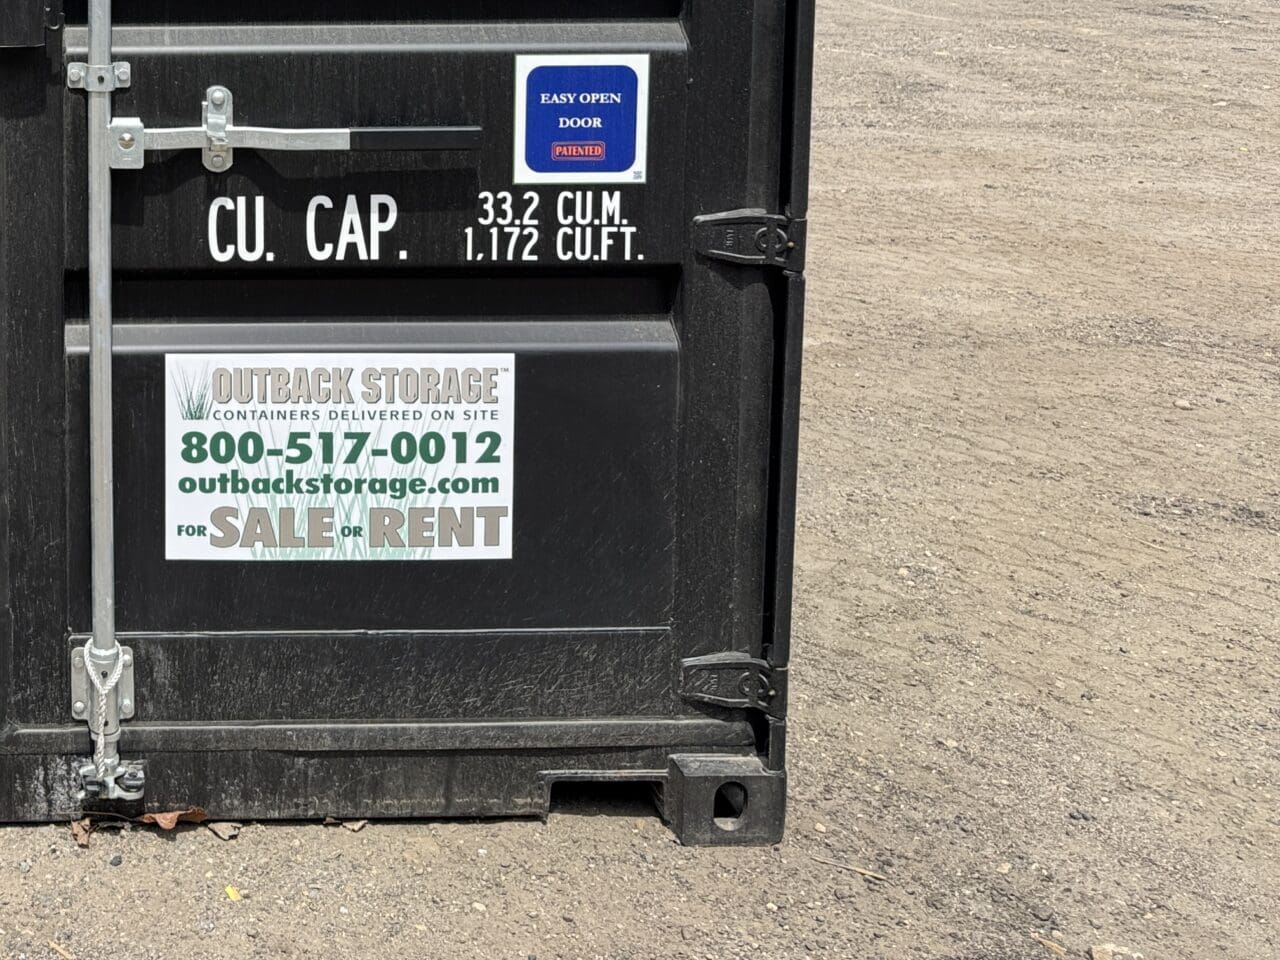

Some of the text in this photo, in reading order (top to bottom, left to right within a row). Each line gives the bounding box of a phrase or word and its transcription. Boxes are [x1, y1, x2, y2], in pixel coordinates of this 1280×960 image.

[540, 93, 622, 104] EASY OPEN
[558, 117, 602, 128] DOOR
[555, 146, 602, 156] PATENTED
[477, 191, 628, 226] 33.2 CU.M.
[207, 193, 408, 262] CU. CAP.
[464, 226, 644, 261] 1,172 CU.FT.
[212, 367, 355, 405] OUTBACK
[361, 367, 499, 405] STORAGE
[213, 409, 499, 421] CONTAINERS DELIVERED ON SITE
[181, 431, 502, 465] 800-517-0012
[178, 469, 499, 500] outbackstorage.com
[177, 505, 509, 548] FOR SALE OR RENT
